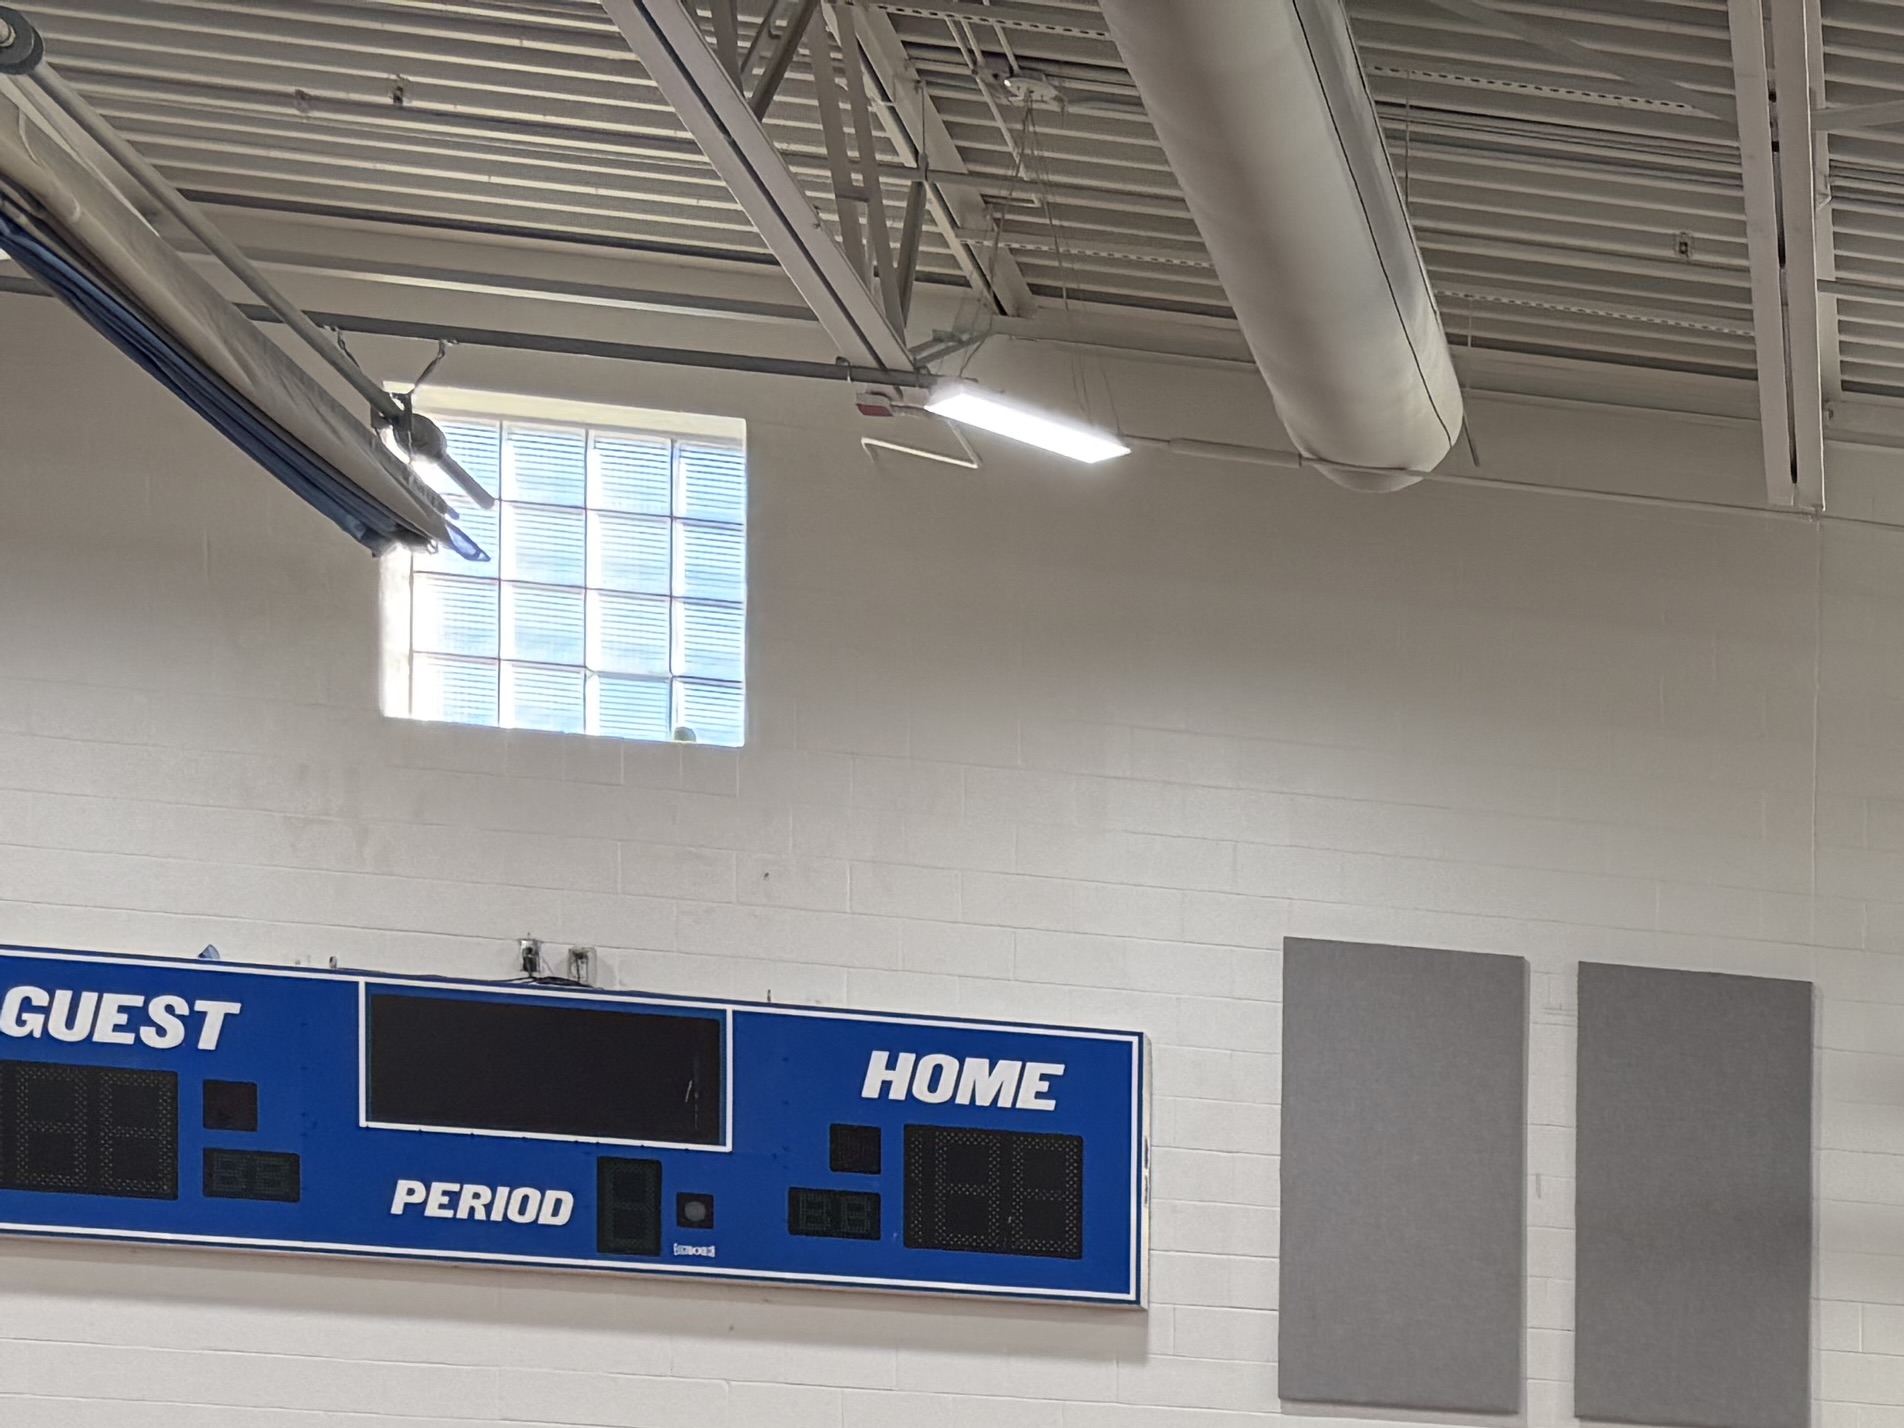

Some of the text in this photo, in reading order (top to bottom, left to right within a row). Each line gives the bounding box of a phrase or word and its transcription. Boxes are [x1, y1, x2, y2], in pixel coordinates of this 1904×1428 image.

[0, 985, 242, 1051] GUEST
[861, 1050, 1066, 1111] HOME
[390, 1179, 574, 1226] PERIOD
